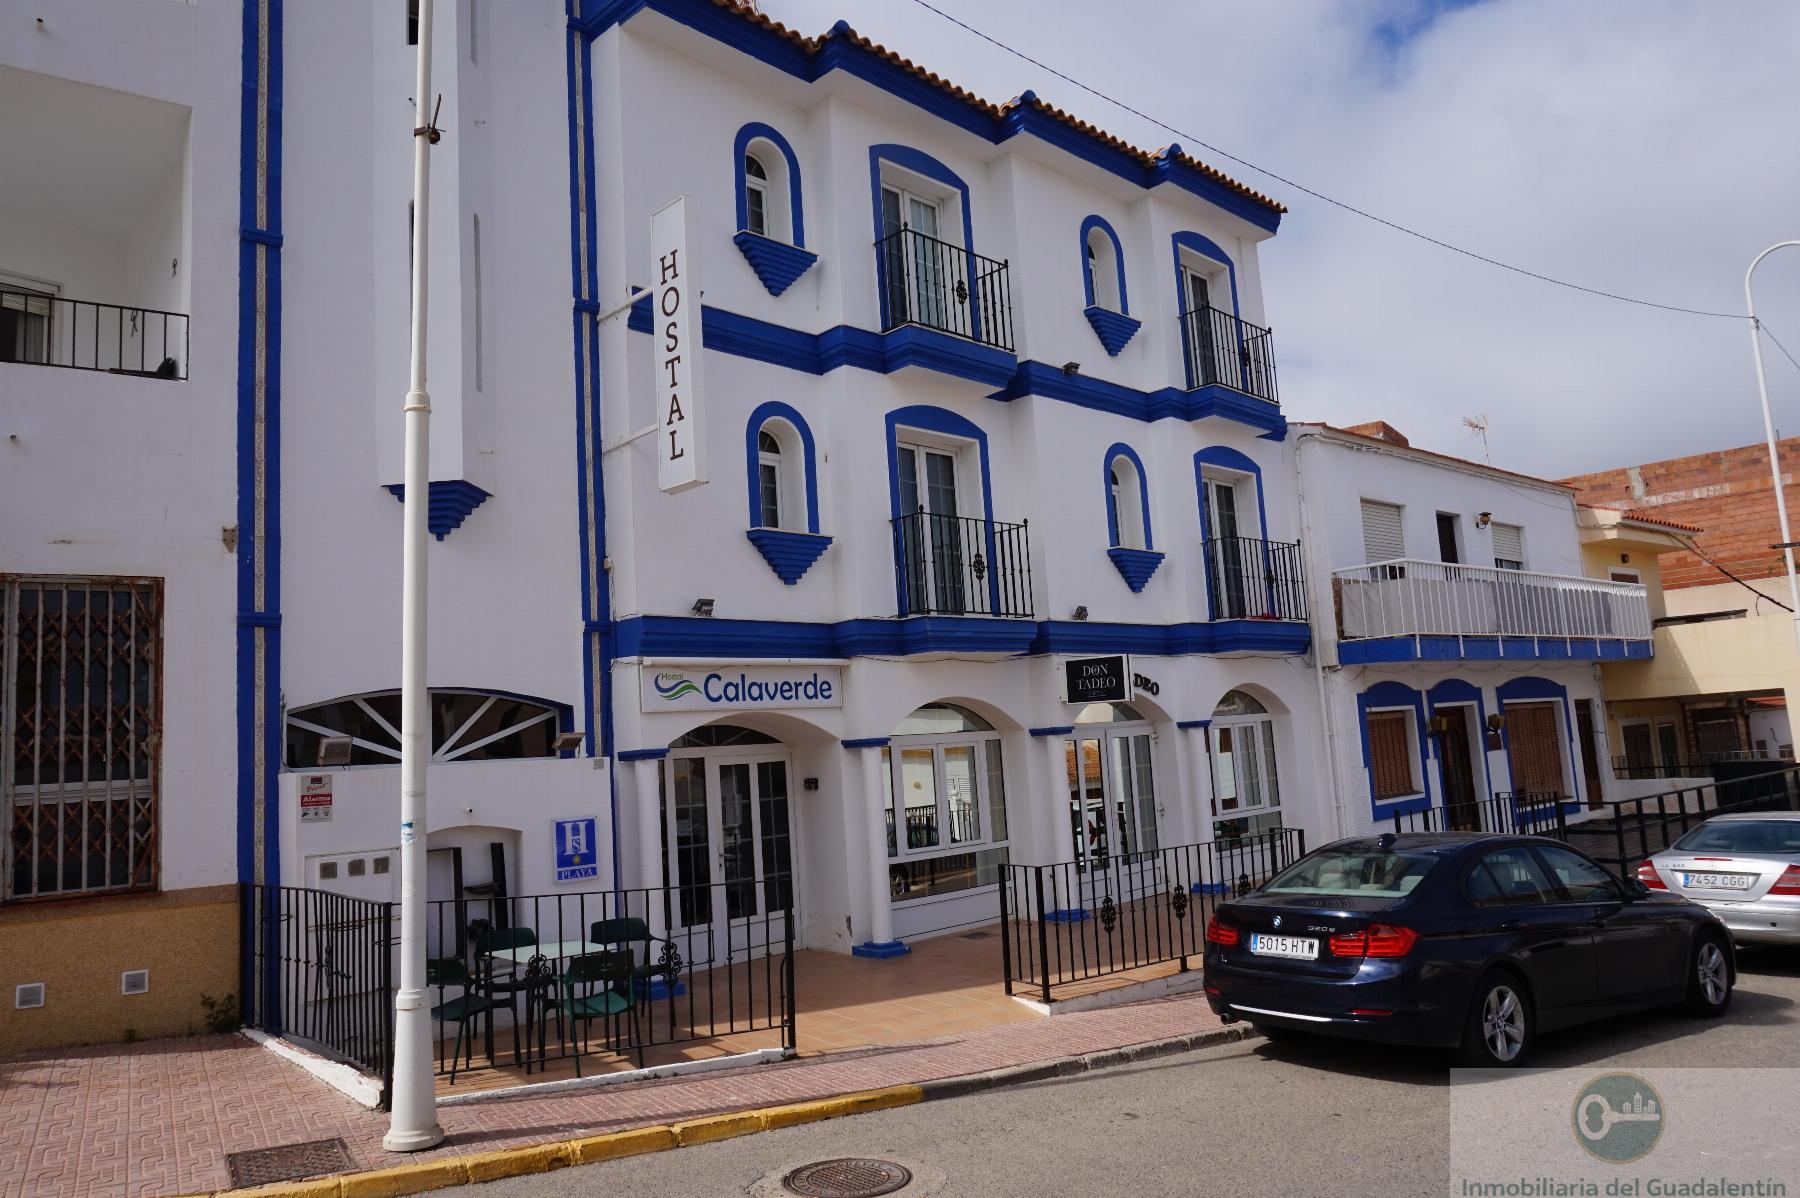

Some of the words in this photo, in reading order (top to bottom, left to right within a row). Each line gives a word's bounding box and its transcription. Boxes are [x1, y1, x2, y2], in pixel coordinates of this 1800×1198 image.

[659, 249, 685, 461] HOSTAL
[661, 672, 684, 681] Hostal
[1082, 664, 1108, 676] DON
[703, 673, 832, 702] Calaverde
[1076, 676, 1116, 690] TADEO
[561, 868, 593, 880] PLAYA
[1689, 874, 1717, 885] 7452
[1722, 876, 1745, 887] CGG
[1259, 936, 1288, 952] 5015
[1291, 939, 1315, 955] HTW
